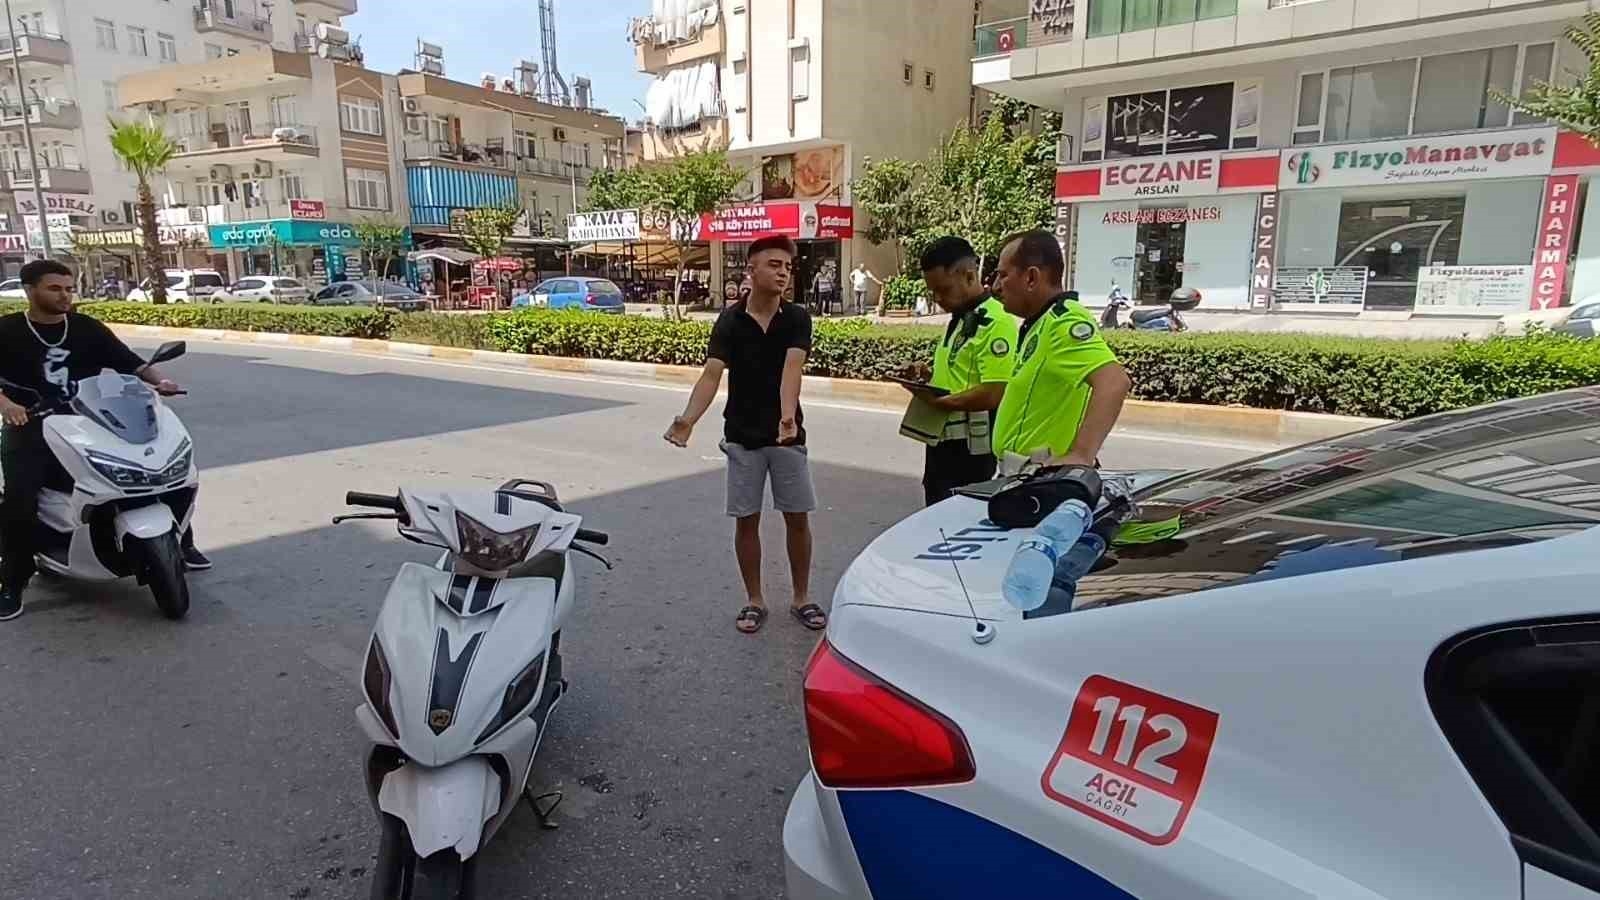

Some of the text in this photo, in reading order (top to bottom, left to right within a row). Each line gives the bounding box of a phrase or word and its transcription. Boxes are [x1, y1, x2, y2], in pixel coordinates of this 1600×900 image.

[1332, 136, 1546, 170] FizyoManavgat
[1105, 158, 1213, 186] ECZANE
[1134, 184, 1179, 196] ARSLAN
[584, 211, 623, 227] KAYA
[1102, 206, 1222, 225] ARSLAN ECZANESİ
[222, 225, 244, 240] eda
[320, 224, 351, 238] eda
[1252, 194, 1276, 308] ECZANE
[1530, 183, 1567, 309] PHARMACY
[1087, 695, 1188, 785] 112
[1085, 772, 1138, 808] ACİL
